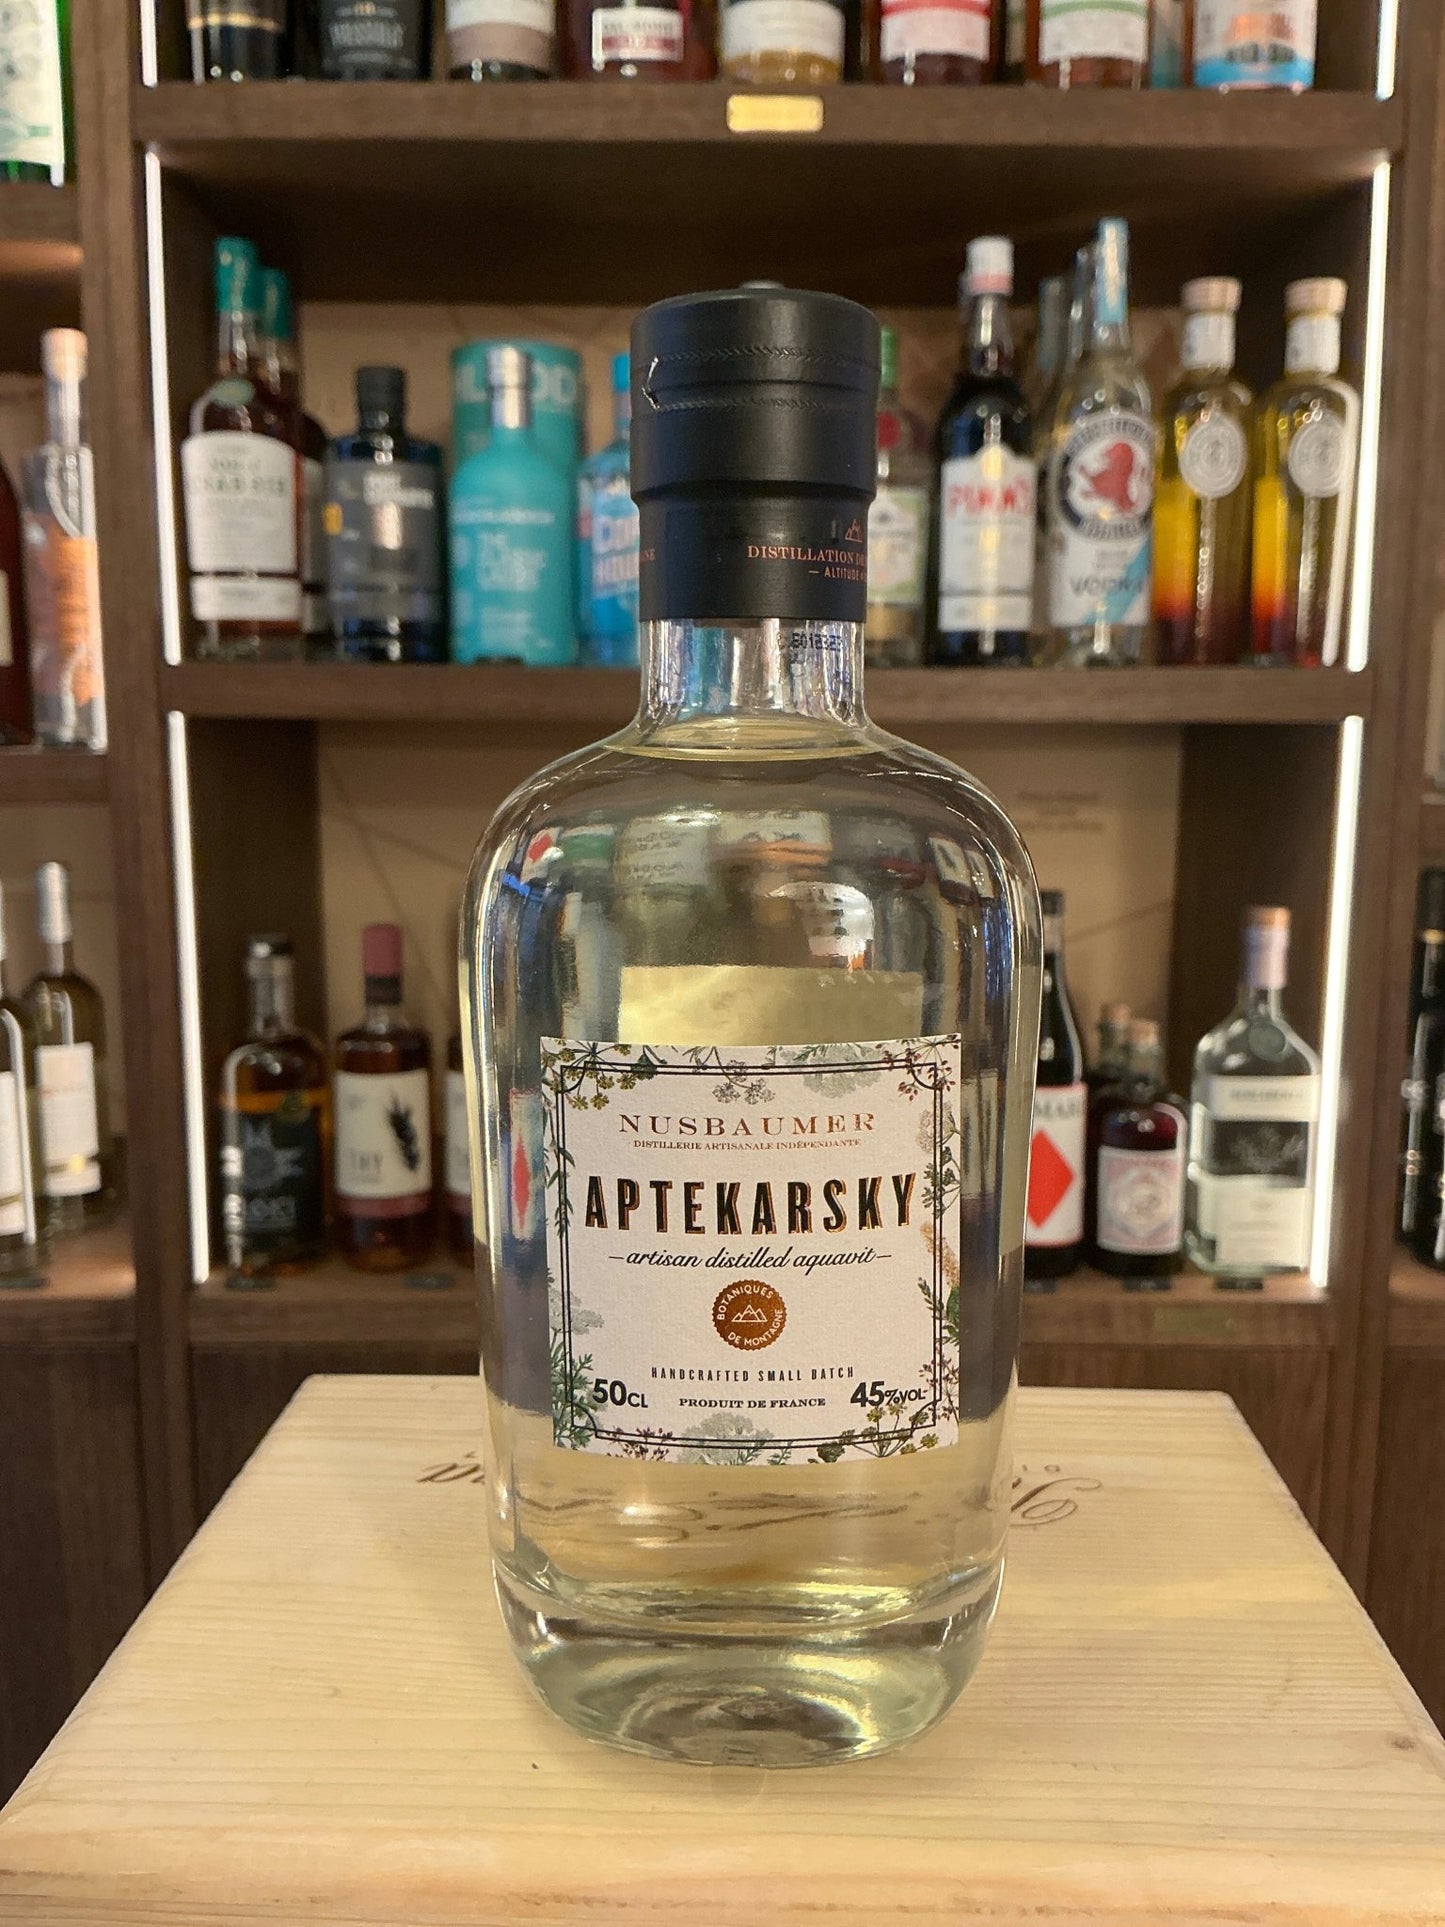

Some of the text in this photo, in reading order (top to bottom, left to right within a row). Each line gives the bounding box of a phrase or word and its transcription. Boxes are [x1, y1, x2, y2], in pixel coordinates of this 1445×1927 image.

[747, 545, 854, 565] DISTILLATION
[824, 566, 860, 581] ALTITUDE
[619, 1112, 875, 1136] NUSBAUMER
[633, 1138, 862, 1151] DISTILLERIE ARTISANALE INDÉPENDANTE
[585, 1172, 916, 1235] APTEKARSKY
[705, 1246, 794, 1268] distilled
[717, 1284, 774, 1320] BOTANIQUES
[728, 1308, 783, 1346] DE MONTAGNE
[652, 1366, 854, 1382] HANDCRAFTED SMALL BATCH
[679, 1398, 826, 1409] PRODUIT DE FRANCE
